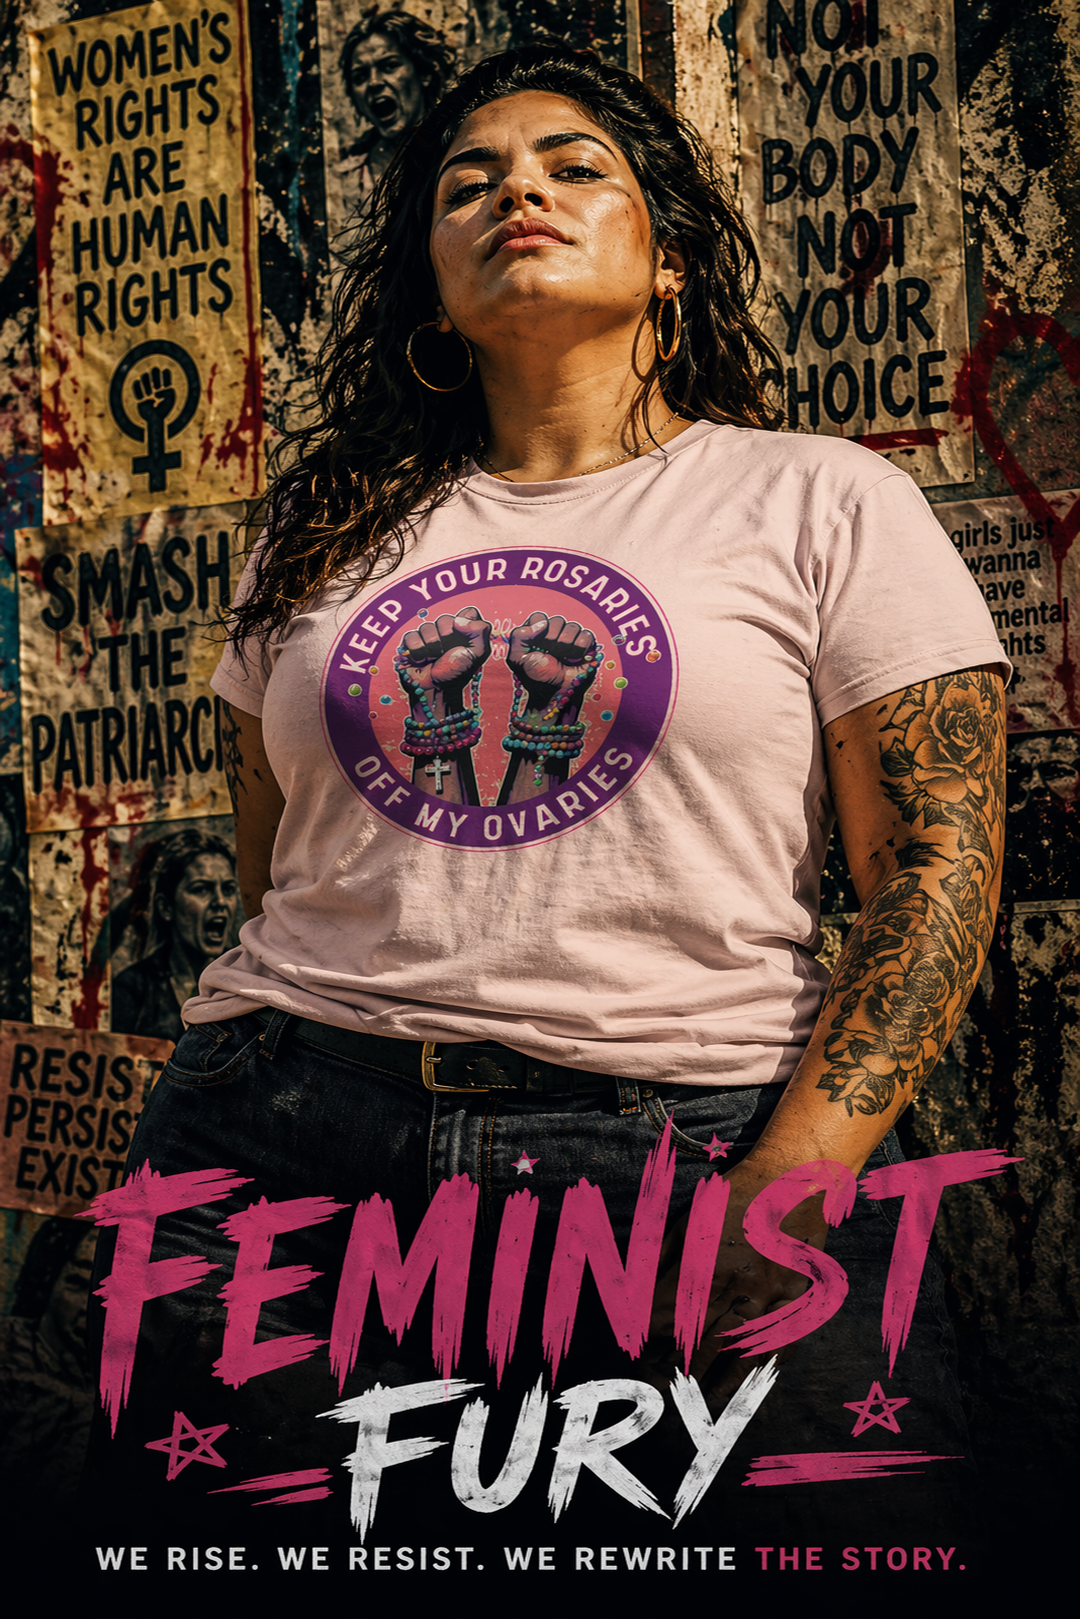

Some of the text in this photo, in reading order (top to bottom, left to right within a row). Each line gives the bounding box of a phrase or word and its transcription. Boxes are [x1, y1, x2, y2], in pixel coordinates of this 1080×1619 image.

[48, 11, 232, 96] WOMEN'S
[795, 52, 943, 128] YOUR
[75, 74, 220, 151] RIGHTS
[102, 140, 186, 205] ARE
[761, 126, 919, 206] BODY
[72, 193, 229, 274] HUMAN
[797, 202, 917, 278] NOT
[75, 258, 233, 337] RIGHTS
[774, 277, 935, 355] YOUR
[951, 516, 1055, 551] girls just
[41, 531, 231, 631] SMASH
[339, 556, 658, 674] KEEP YOUR ROSARIES
[98, 626, 188, 692] THE
[354, 747, 633, 841] OFF MY OVARIES
[4, 1095, 141, 1154] PERSIS
